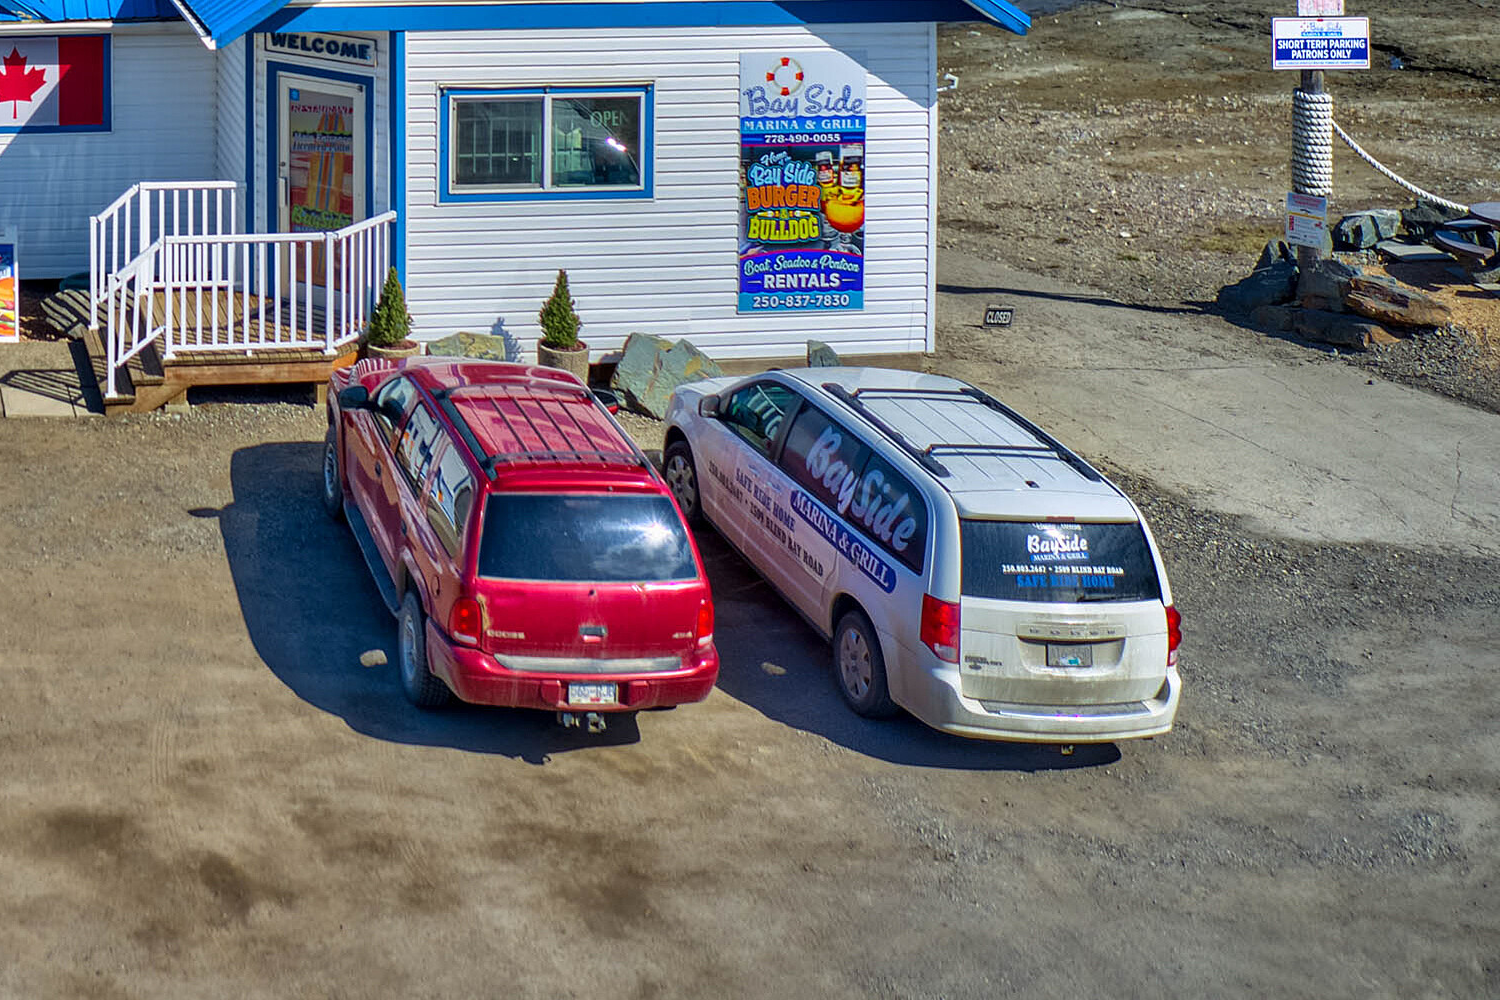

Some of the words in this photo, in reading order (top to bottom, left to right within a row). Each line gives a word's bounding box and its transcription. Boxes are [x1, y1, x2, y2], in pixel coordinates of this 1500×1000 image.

[270, 32, 370, 60] WELCOME
[1277, 40, 1304, 49] SHORT
[1306, 40, 1328, 49] TERM
[1330, 39, 1365, 49] PARKING
[1291, 50, 1329, 59] PATRONS
[1330, 49, 1352, 59] ONLY
[743, 86, 798, 118] Bay
[805, 84, 863, 114] Side
[590, 110, 628, 127] OPEN
[744, 121, 799, 131] MARINA
[805, 120, 816, 129] &
[821, 119, 863, 129] GRILL
[764, 134, 841, 143] 778-490-0055
[750, 163, 783, 187] Bay
[784, 162, 815, 185] Side
[747, 184, 821, 210] BURGER
[748, 217, 819, 241] BULLDOG
[775, 255, 810, 270] Seadoo
[820, 255, 860, 273] Pontoon
[764, 273, 841, 289] RENTALS
[752, 295, 850, 308] 250-837-7830
[736, 467, 753, 494] SAFE
[753, 486, 771, 512] RIDE
[773, 500, 796, 532] HOME
[766, 513, 787, 544] BLIND
[803, 547, 824, 578] ROAD
[792, 490, 838, 542] MARINA
[838, 532, 851, 552] &
[851, 542, 890, 588] GRILL
[1081, 575, 1115, 587] HOME
